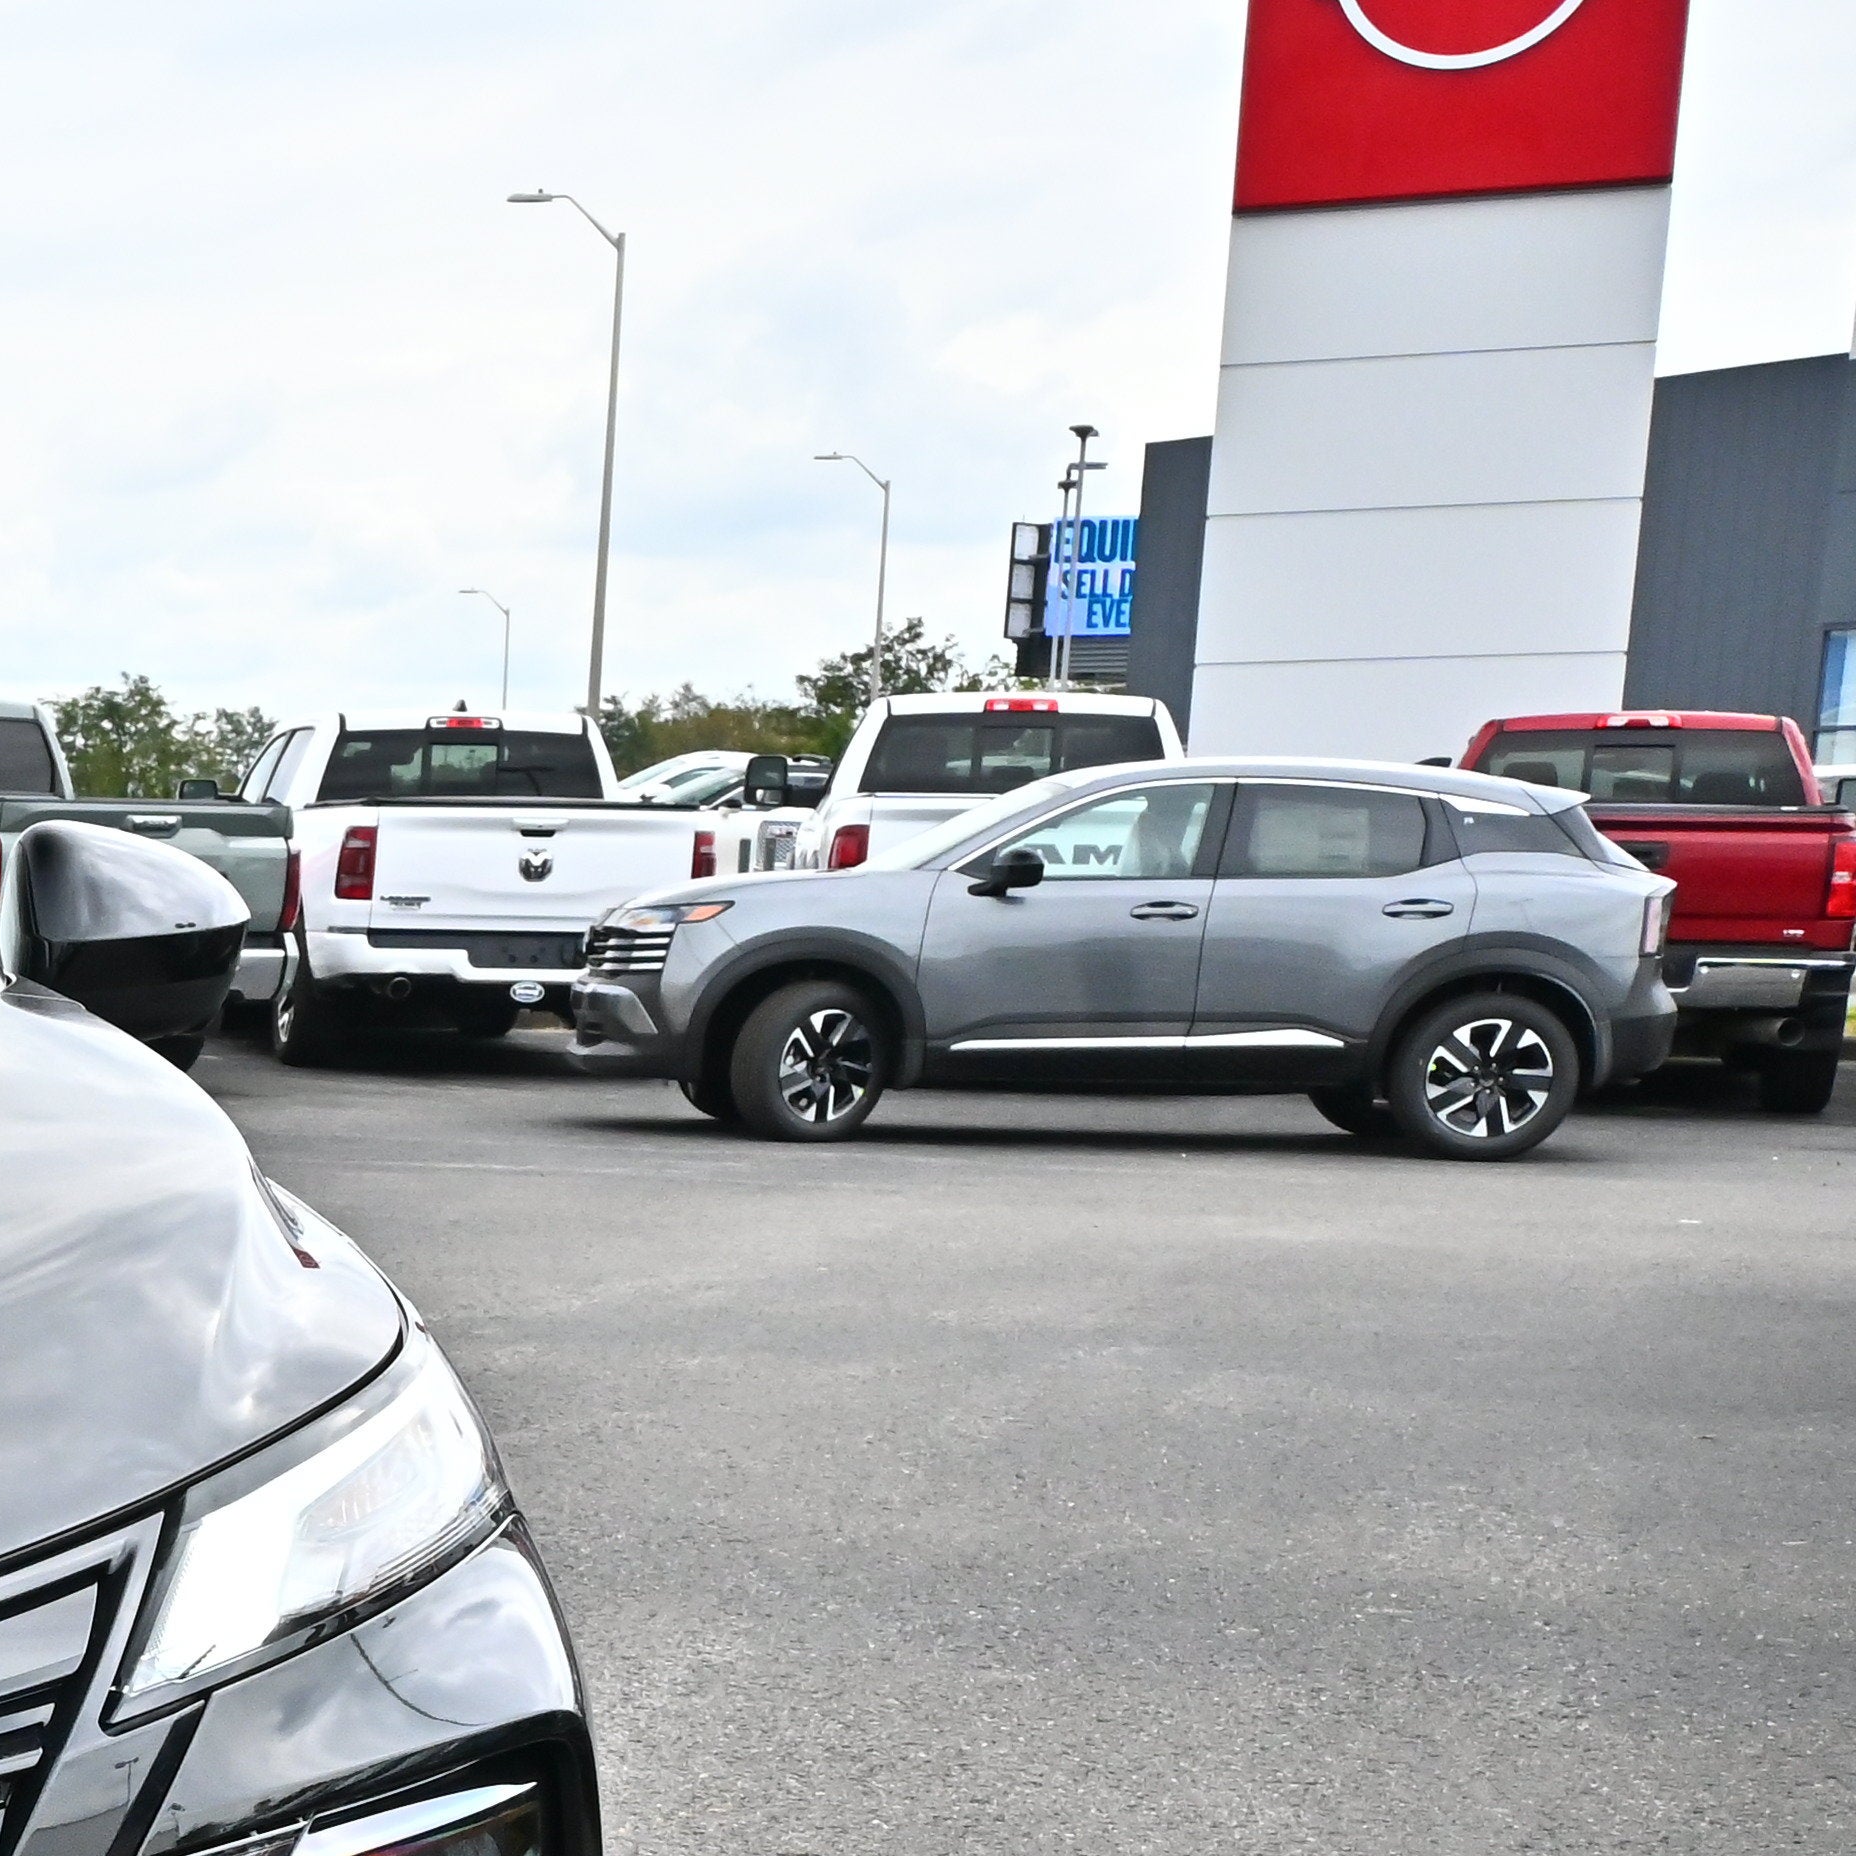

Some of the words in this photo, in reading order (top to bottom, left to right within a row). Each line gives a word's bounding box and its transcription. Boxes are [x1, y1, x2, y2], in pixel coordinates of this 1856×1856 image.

[1054, 519, 1136, 563] EQUI
[1060, 568, 1114, 599] SELL
[1086, 599, 1132, 628] EVE
[1024, 843, 1124, 865] AM
